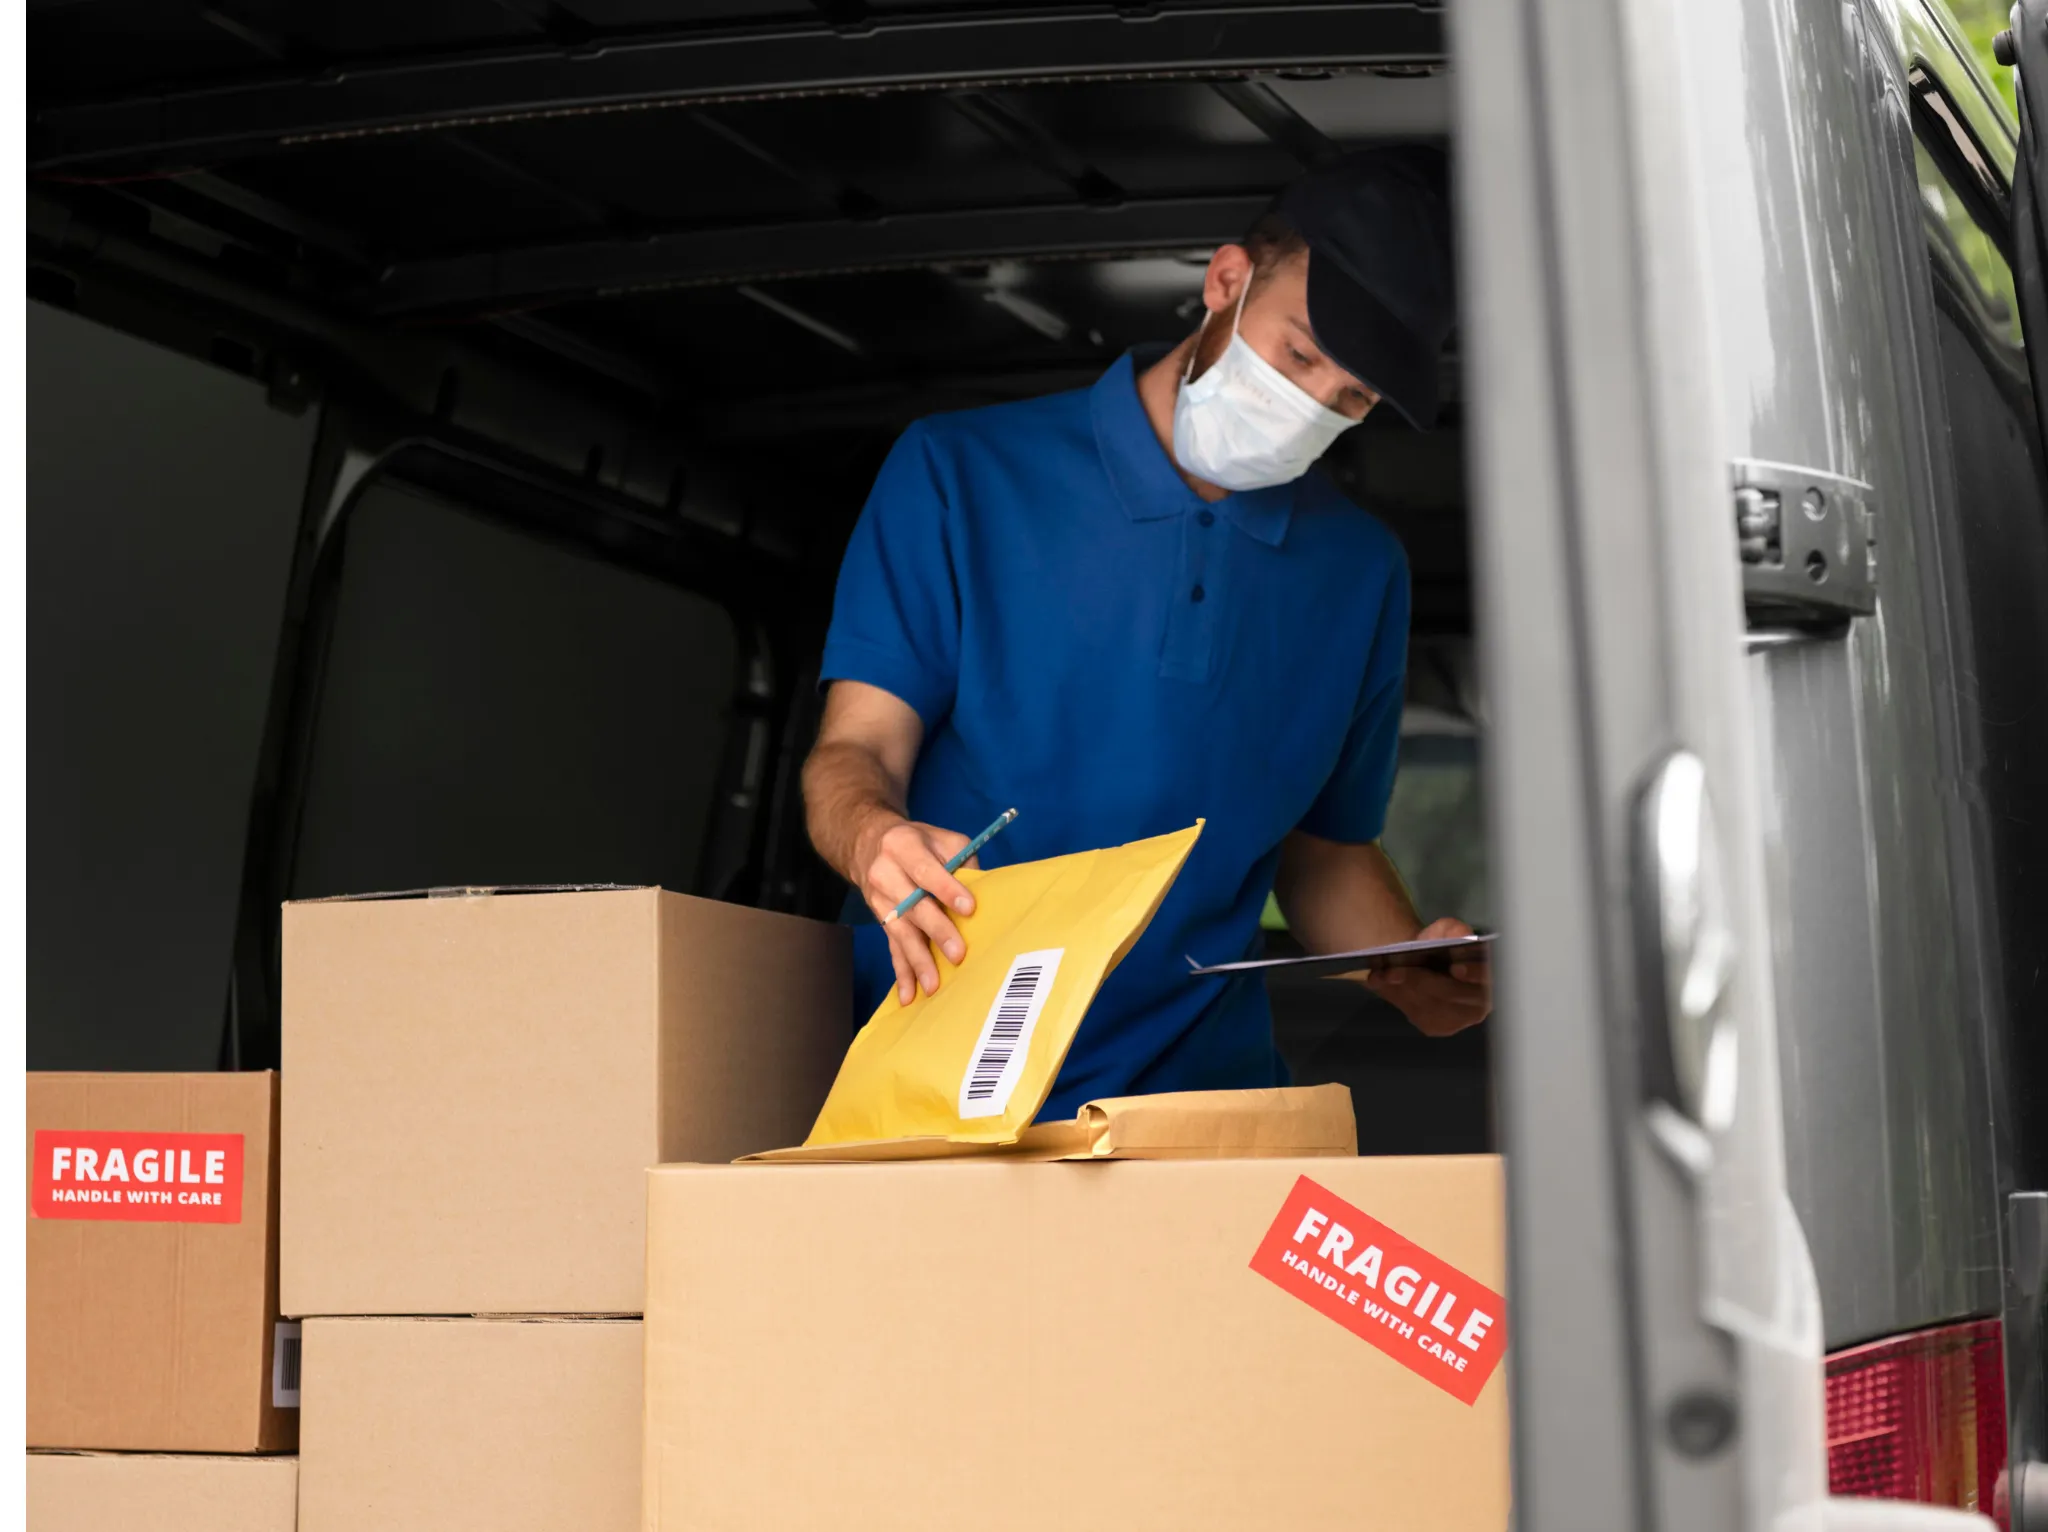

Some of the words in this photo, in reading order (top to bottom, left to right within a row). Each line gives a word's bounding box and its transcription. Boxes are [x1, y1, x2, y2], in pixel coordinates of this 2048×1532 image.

[52, 1147, 225, 1184] FRAGILE
[52, 1189, 122, 1204] HANDLE
[126, 1190, 173, 1205] WITH
[177, 1191, 222, 1206] CARE
[1281, 1249, 1361, 1306] HANDLE
[1363, 1298, 1415, 1340] WITH
[1417, 1334, 1468, 1373] CARE
[1292, 1206, 1494, 1352] FRAGILE
